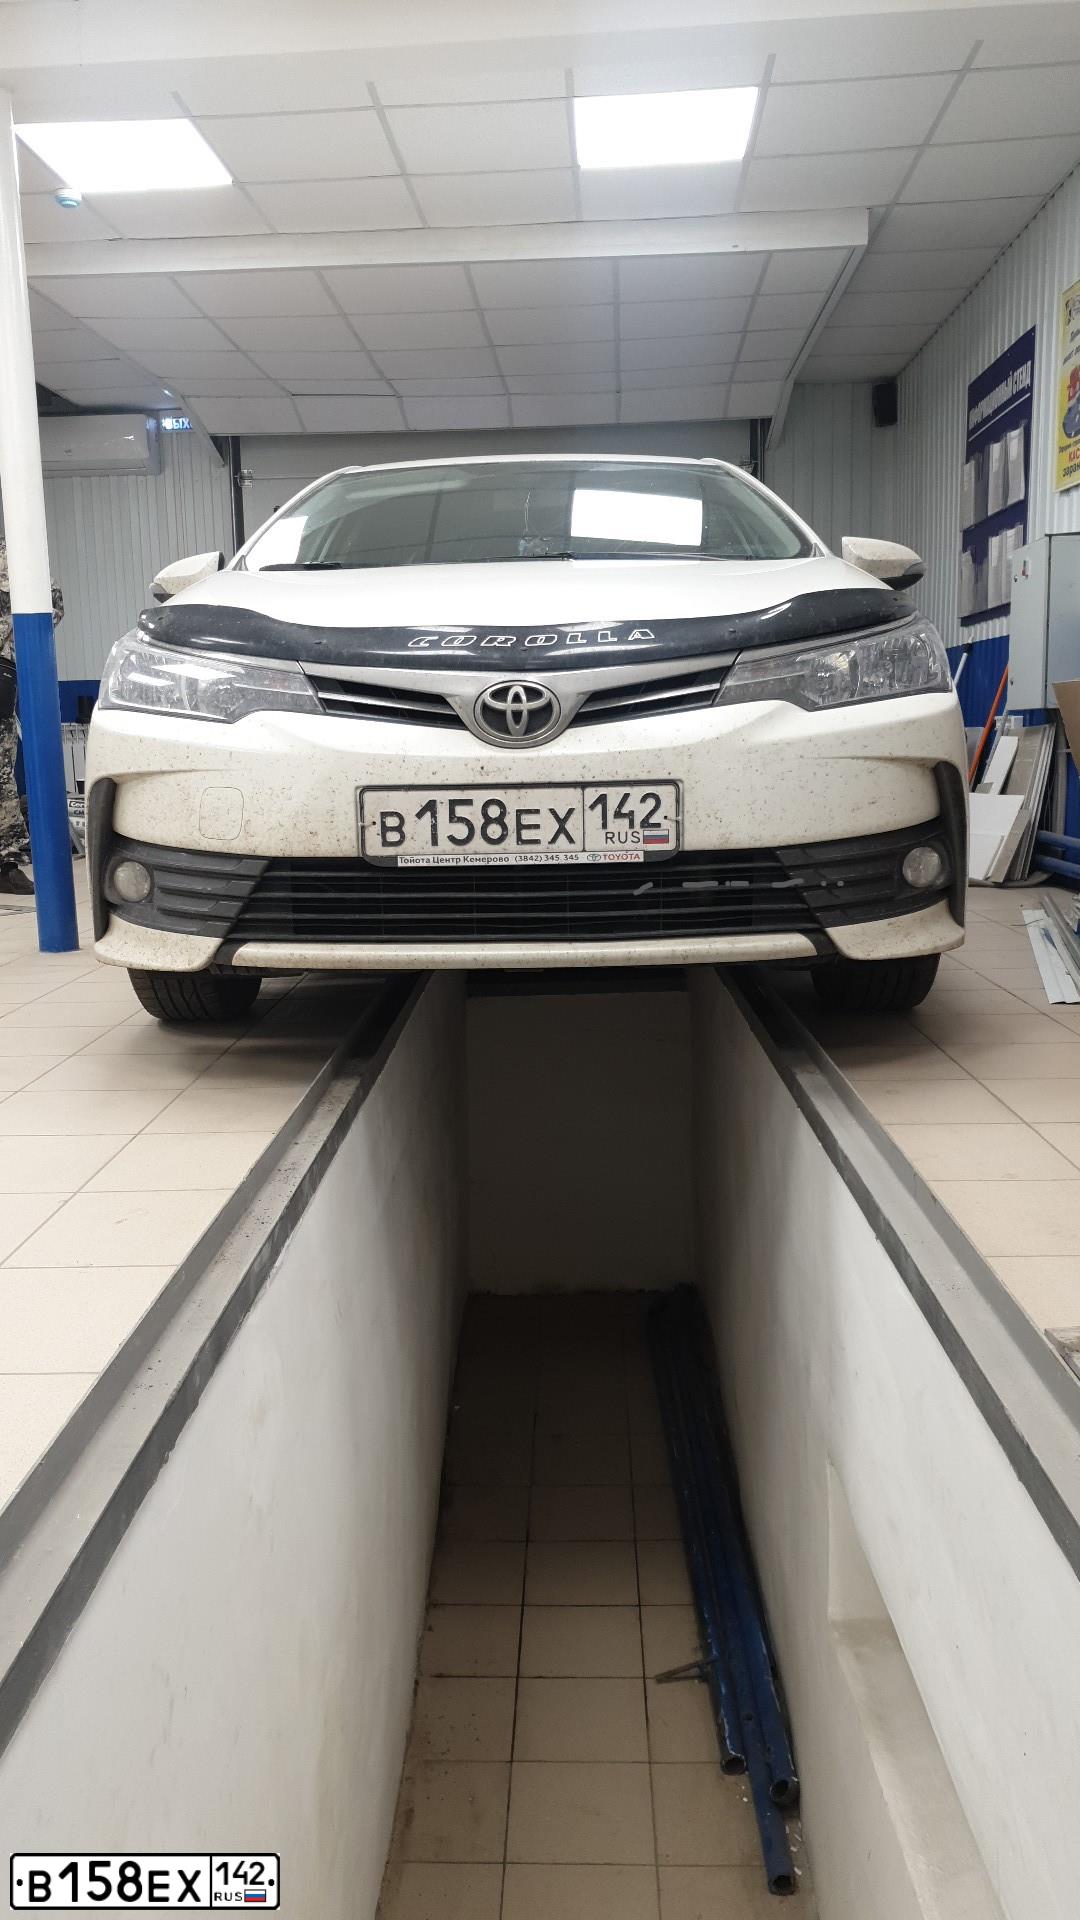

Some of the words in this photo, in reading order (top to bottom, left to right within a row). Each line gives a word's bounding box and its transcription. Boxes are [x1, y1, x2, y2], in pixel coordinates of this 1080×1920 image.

[1013, 360, 1032, 395] СТЕНД
[408, 629, 655, 647] COROLLA
[588, 792, 662, 830] 142
[604, 830, 641, 845] RUS
[400, 856, 431, 865] Тойота
[433, 856, 461, 865] Центр
[463, 855, 510, 865] Кемерово
[514, 854, 543, 863] (3842)
[544, 854, 560, 862] 345
[563, 854, 579, 862] 345
[602, 853, 640, 862] TOYOTA
